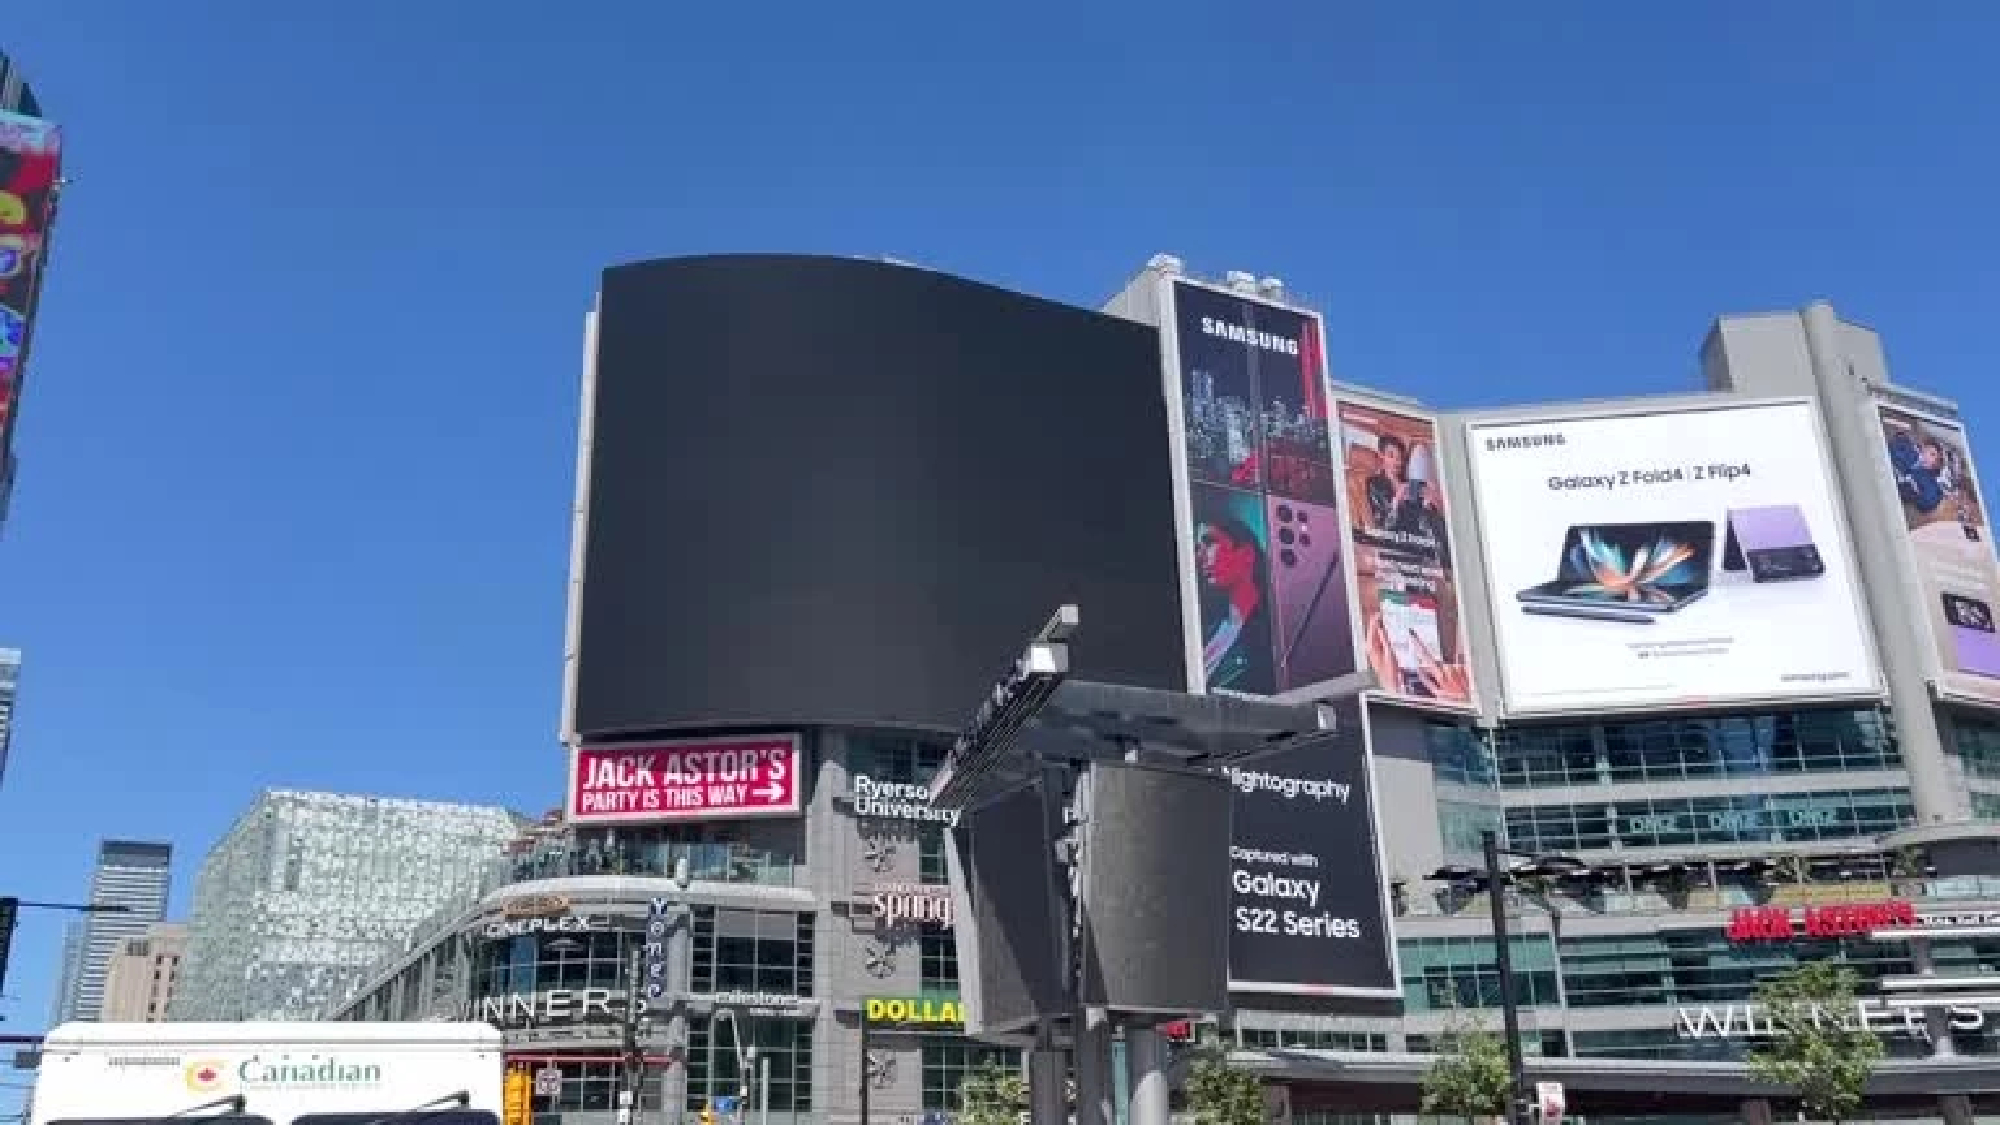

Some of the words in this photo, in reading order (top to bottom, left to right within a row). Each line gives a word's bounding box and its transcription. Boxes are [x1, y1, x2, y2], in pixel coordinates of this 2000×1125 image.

[1202, 317, 1298, 355] SAMSUNG
[1485, 432, 1566, 451] SAMSUNG
[1548, 474, 1616, 491] Galaxy
[1619, 470, 1630, 485] Z
[1633, 467, 1683, 485] Fold4
[1708, 462, 1751, 483] Flip4
[582, 756, 655, 790] JACK
[664, 749, 786, 784] ASTOR'S
[583, 789, 638, 812] PARTY
[642, 789, 660, 809] IS
[666, 786, 704, 808] THIS
[708, 783, 748, 806] WAY
[855, 774, 929, 801] Ryerso
[1233, 870, 1320, 908] Galaxy
[1236, 906, 1280, 934] S22
[1284, 911, 1360, 938] Series
[238, 1054, 382, 1083] Canadian
